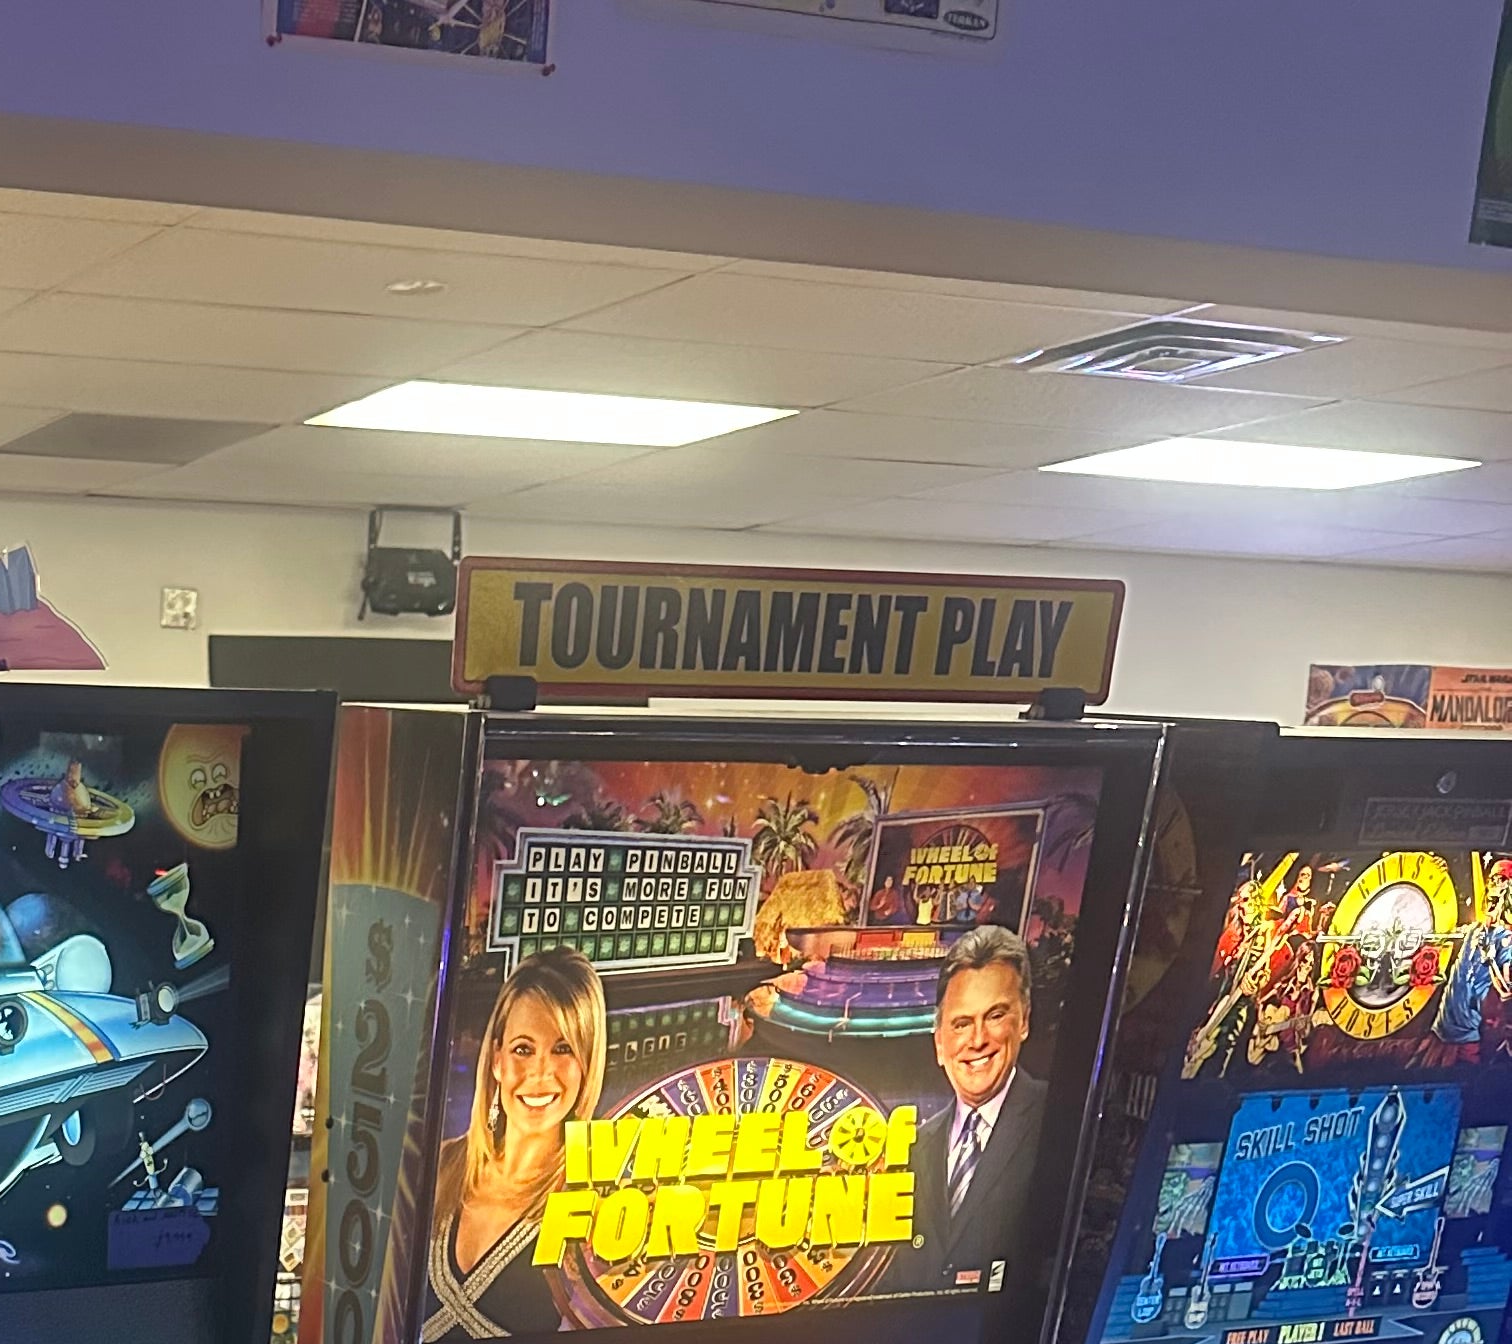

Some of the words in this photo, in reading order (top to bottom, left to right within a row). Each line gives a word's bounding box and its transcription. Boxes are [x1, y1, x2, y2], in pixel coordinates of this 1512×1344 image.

[514, 581, 928, 675] TOURNAMENT
[934, 597, 1073, 679] PLAY
[531, 851, 602, 870] PLAY
[628, 852, 736, 872] PINBALL
[910, 845, 974, 864] WHEEL
[902, 863, 997, 886] FORTUNE
[530, 880, 599, 899] IT'S
[624, 880, 687, 898] MORE
[708, 880, 746, 898] FUN
[527, 910, 557, 929] TO
[585, 907, 699, 927] COMPETE
[1234, 1122, 1295, 1161] SKILL
[1303, 1105, 1366, 1145] SHOT
[564, 1111, 824, 1186] WHEEL
[533, 1171, 916, 1268] FORTUNE
